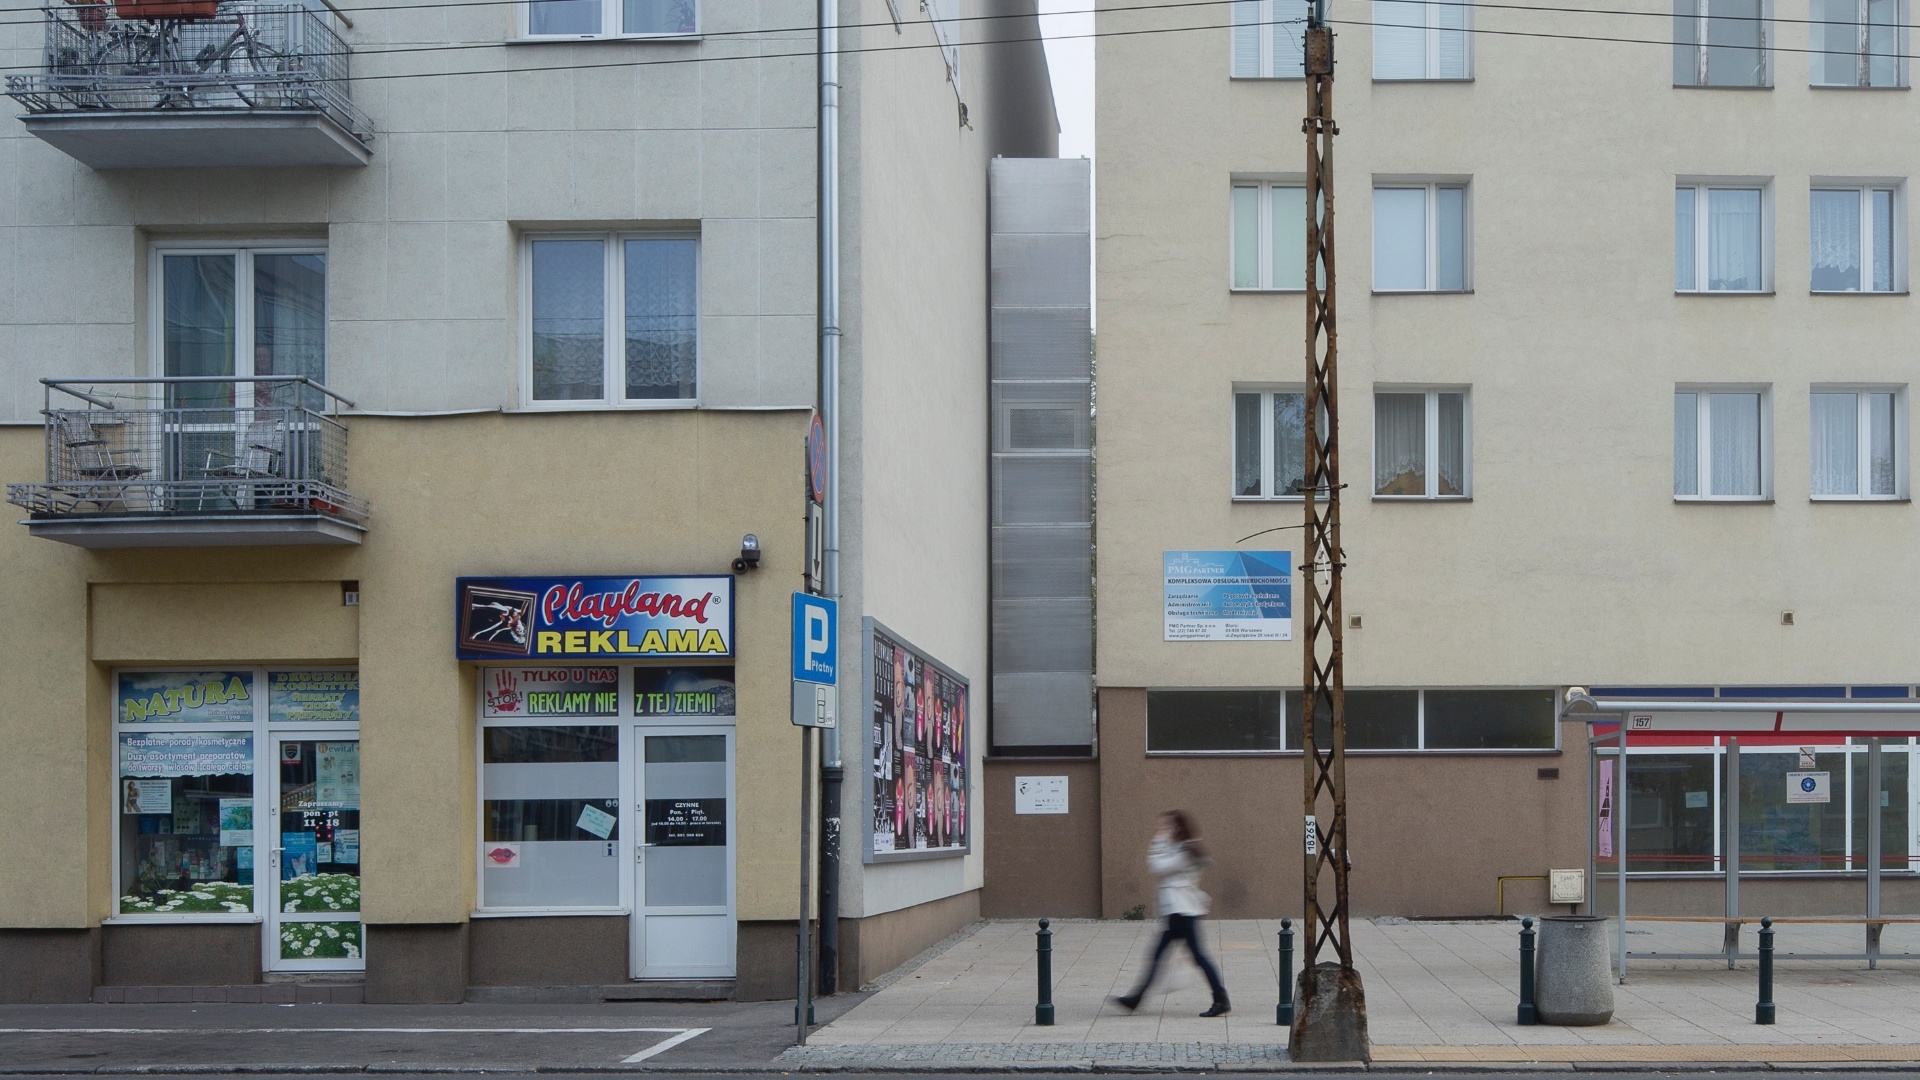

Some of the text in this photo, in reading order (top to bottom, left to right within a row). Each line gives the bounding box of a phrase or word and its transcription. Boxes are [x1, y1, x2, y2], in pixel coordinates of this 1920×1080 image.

[1168, 565, 1192, 574] PMG
[543, 579, 713, 627] Playland
[536, 629, 729, 654] REKLAMA
[804, 603, 829, 671] P
[521, 668, 617, 682] TYLKO U NAS
[811, 660, 834, 678] Płatny
[124, 676, 250, 721] NATURA
[292, 692, 346, 702] HERBATY
[527, 691, 717, 714] REKLAMY NIE Z TEJ ZIEMI!
[287, 711, 353, 720] PREPARATY
[1635, 717, 1650, 727] 157
[169, 736, 196, 748] porady
[198, 735, 247, 748] kosmetyczne
[149, 752, 196, 762] asortyment
[199, 750, 246, 762] preparatów
[127, 762, 137, 772] do
[298, 800, 344, 808] Zapraszamy
[303, 810, 321, 818] pon
[328, 810, 339, 818] pt
[303, 818, 316, 827] 11
[325, 818, 340, 827] 18
[1305, 820, 1316, 851] 18265
